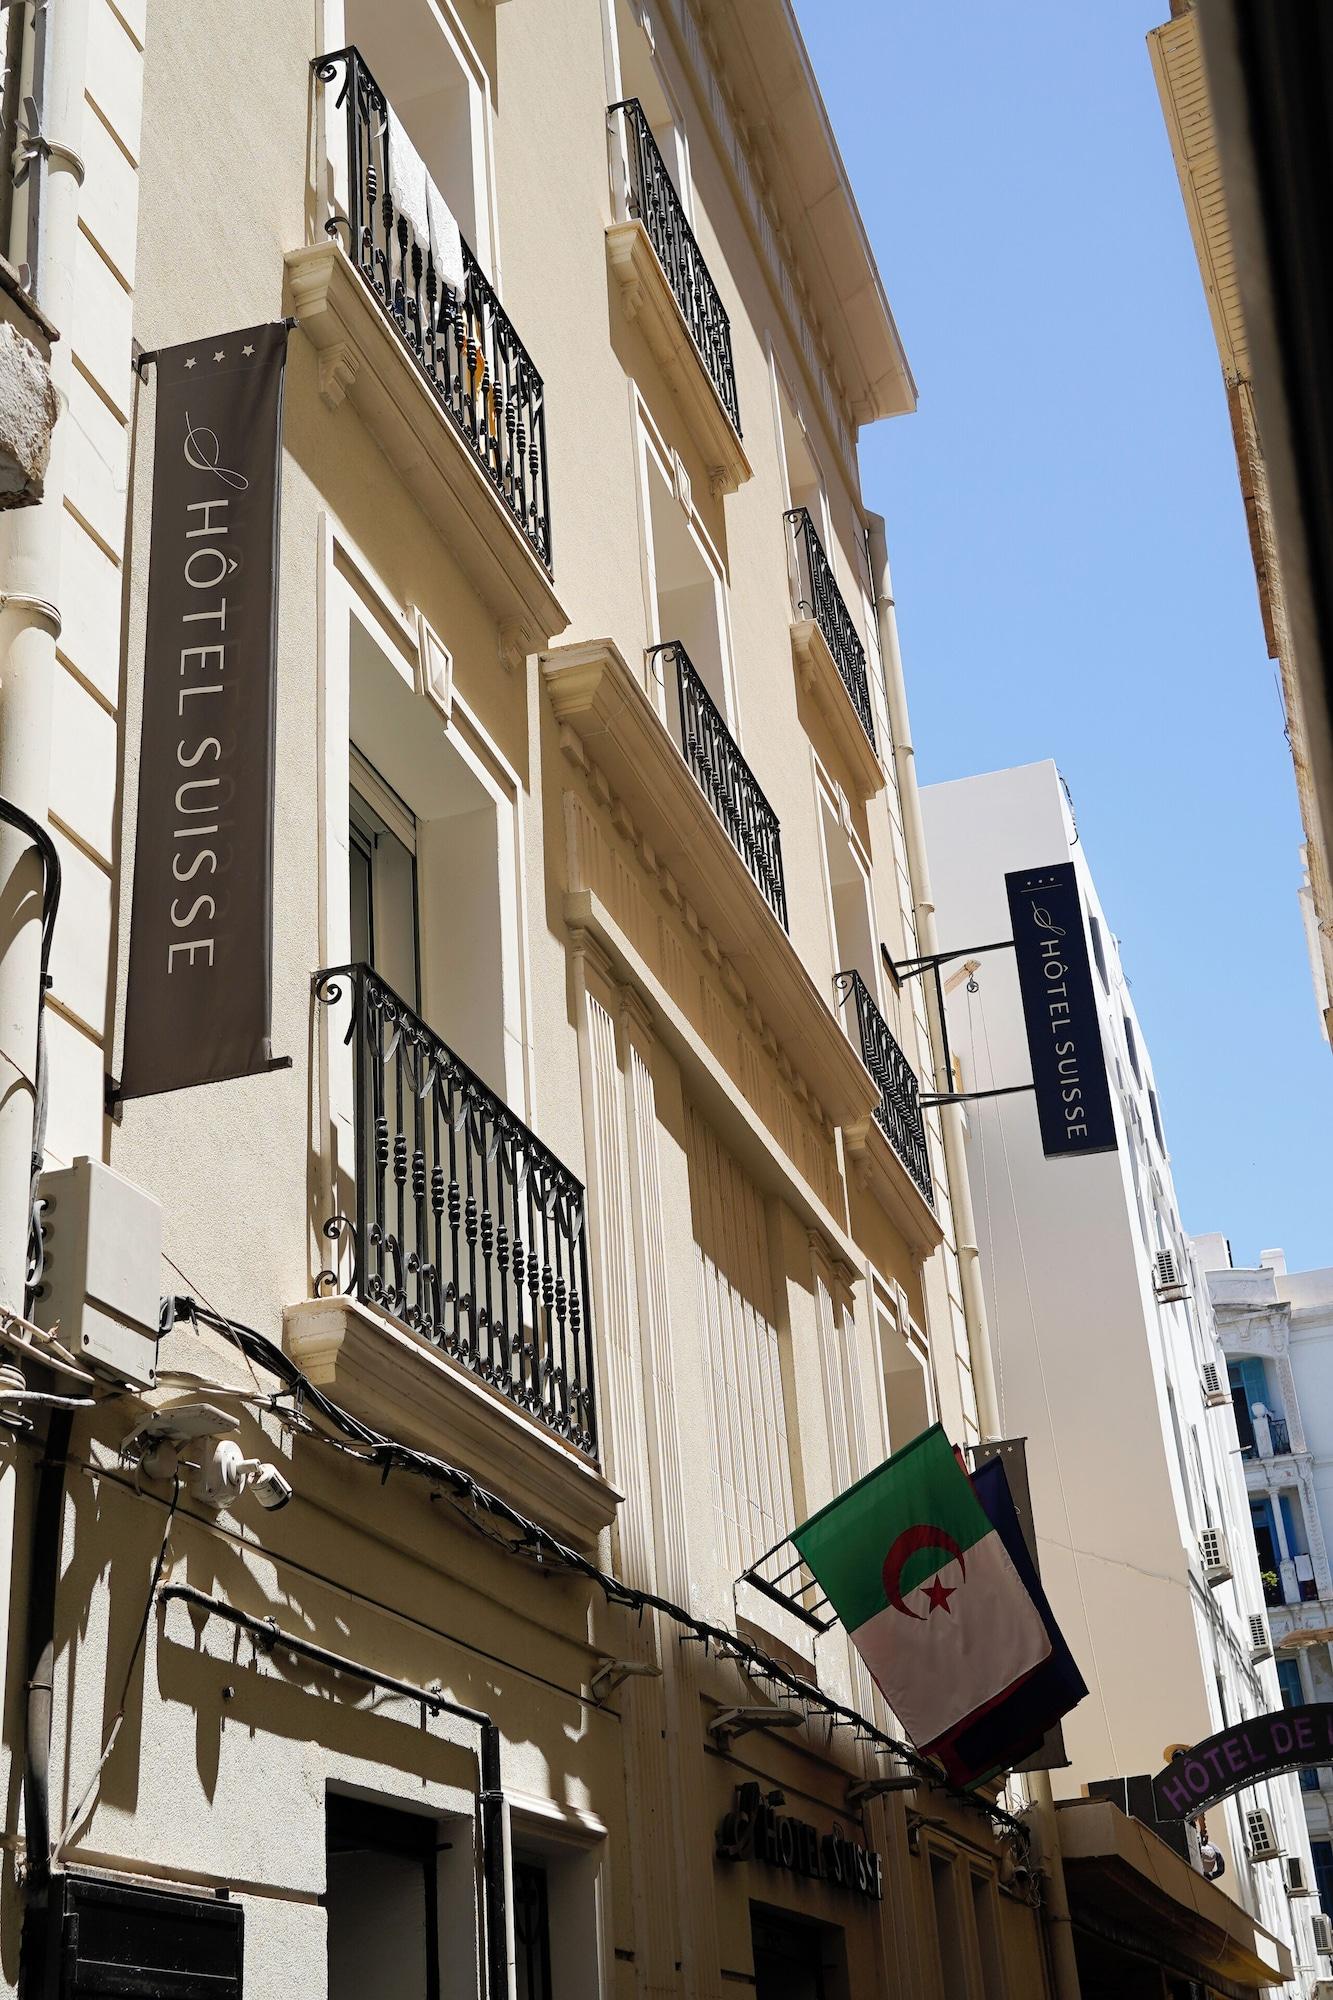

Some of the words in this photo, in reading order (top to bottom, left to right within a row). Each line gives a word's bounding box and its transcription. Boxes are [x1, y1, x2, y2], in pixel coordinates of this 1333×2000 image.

[178, 499, 238, 716] HÔTEL
[167, 736, 222, 974] SUISSE
[1040, 939, 1070, 1033] HÔTEL
[1055, 1041, 1088, 1139] SUISSE
[1162, 1733, 1267, 1812] HÔTEL
[1269, 1716, 1316, 1755] DE
